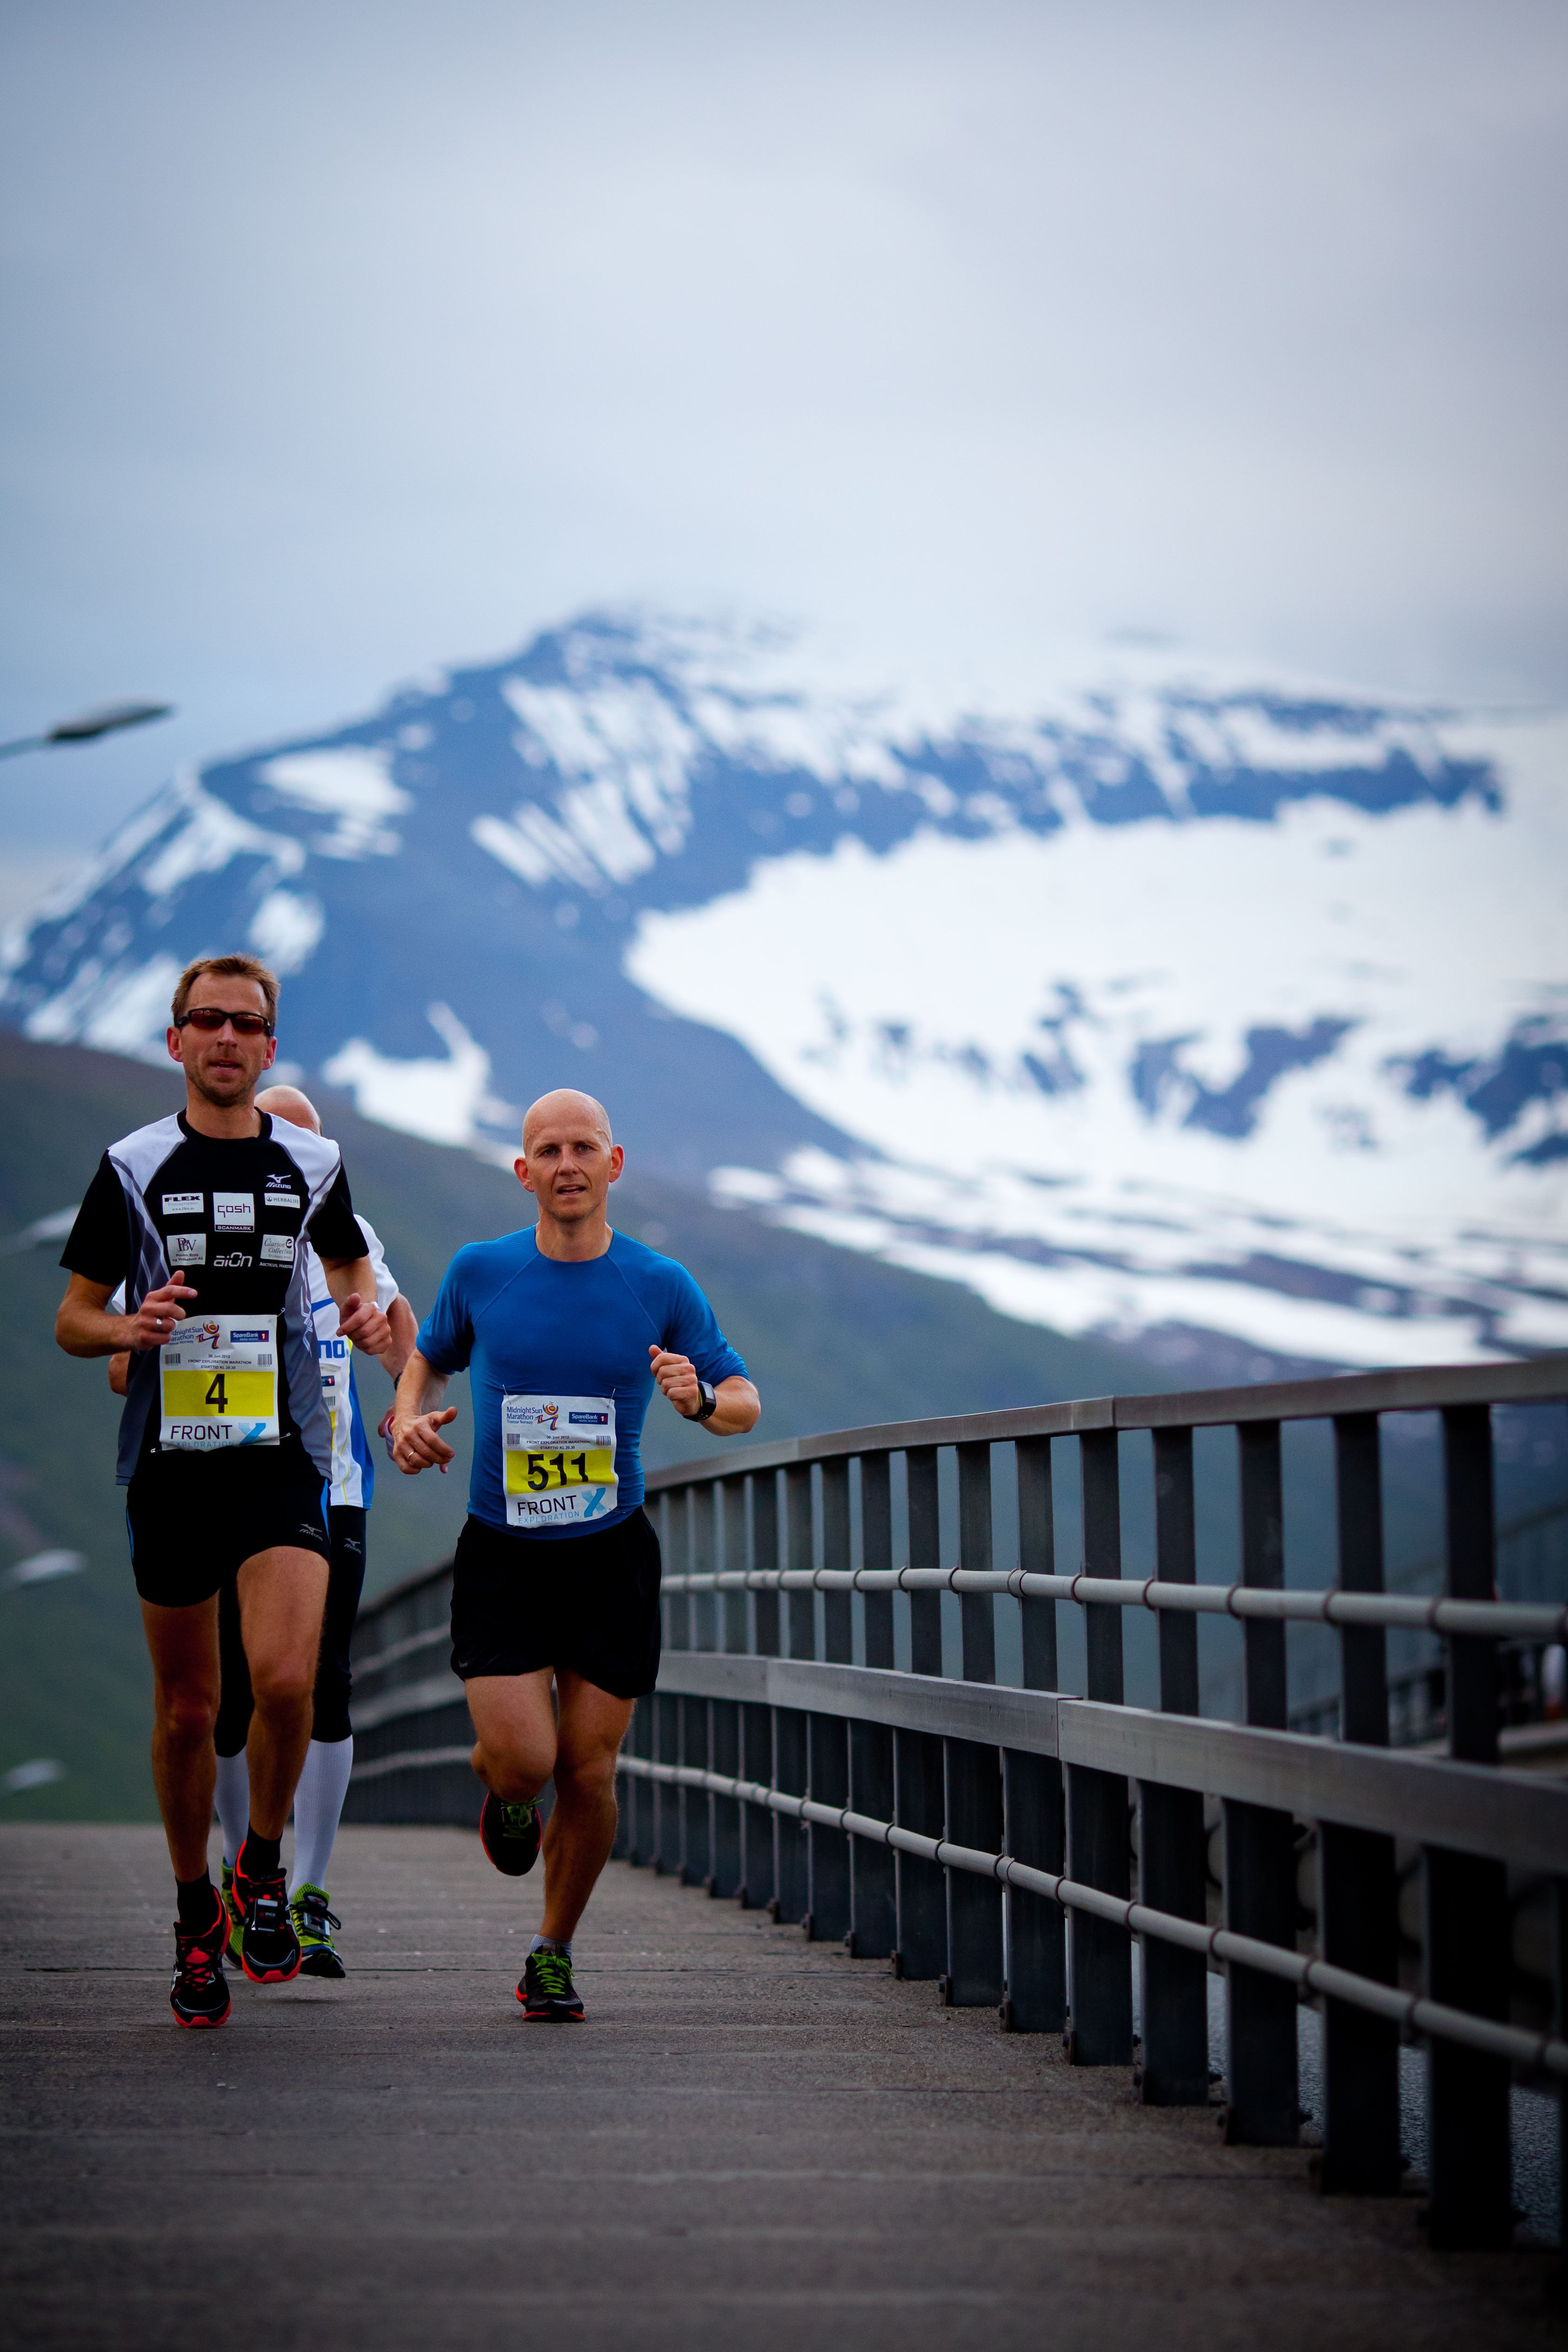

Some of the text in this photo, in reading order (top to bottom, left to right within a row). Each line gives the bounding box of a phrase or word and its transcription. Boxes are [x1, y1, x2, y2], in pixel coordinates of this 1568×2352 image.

[218, 1203, 251, 1218] gosh
[265, 1238, 285, 1248] Clarion
[170, 1327, 203, 1335] idnightSun
[205, 1374, 228, 1413] 4
[171, 1425, 232, 1440] FRONT
[528, 1453, 589, 1491] 511
[517, 1495, 577, 1516] FRONT
[518, 1511, 579, 1524] EXPLORATION
